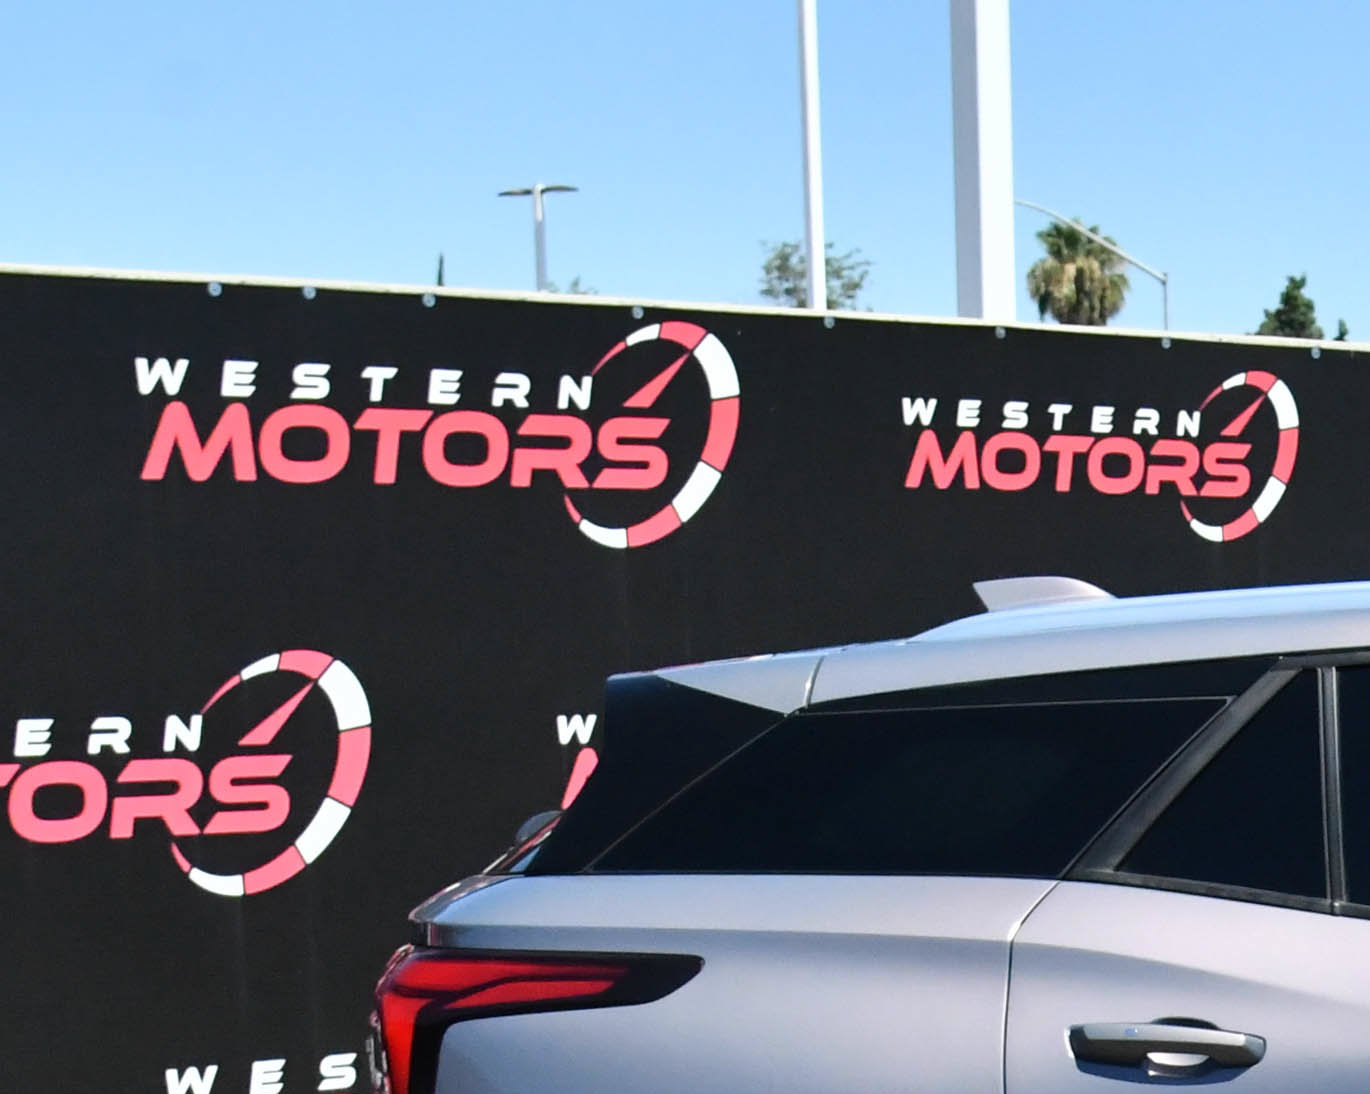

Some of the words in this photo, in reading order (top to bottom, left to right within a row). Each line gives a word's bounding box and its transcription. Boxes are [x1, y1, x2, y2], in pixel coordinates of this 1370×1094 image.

[135, 357, 593, 409] WESTERN
[141, 401, 670, 490] MOTORS
[902, 397, 1200, 437] WESTERN
[905, 430, 1252, 498] MOTORS
[13, 714, 203, 757] ERN
[0, 754, 292, 843] ORS
